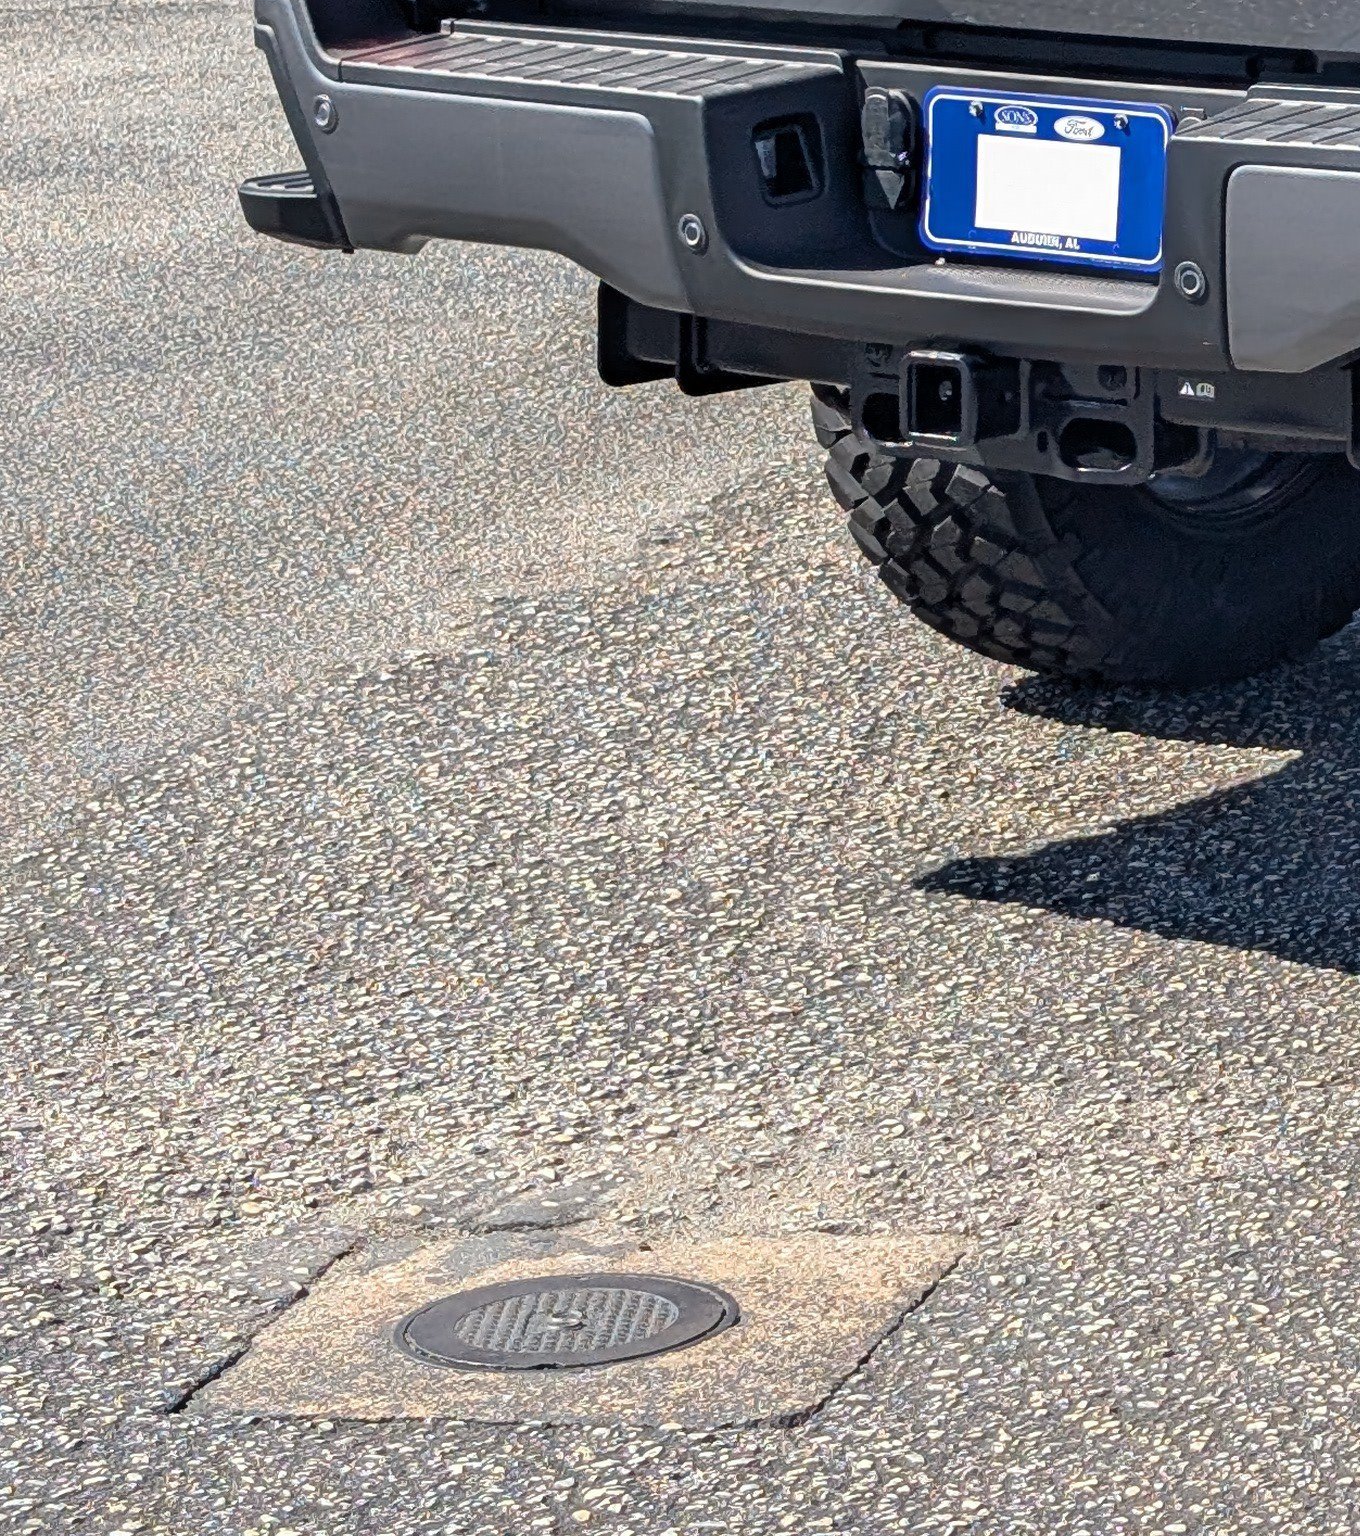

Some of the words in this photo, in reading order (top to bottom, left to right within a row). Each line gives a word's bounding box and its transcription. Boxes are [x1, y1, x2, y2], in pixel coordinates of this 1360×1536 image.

[1001, 109, 1033, 126] SONS
[1064, 118, 1095, 138] Ford
[1064, 237, 1081, 251] AL
